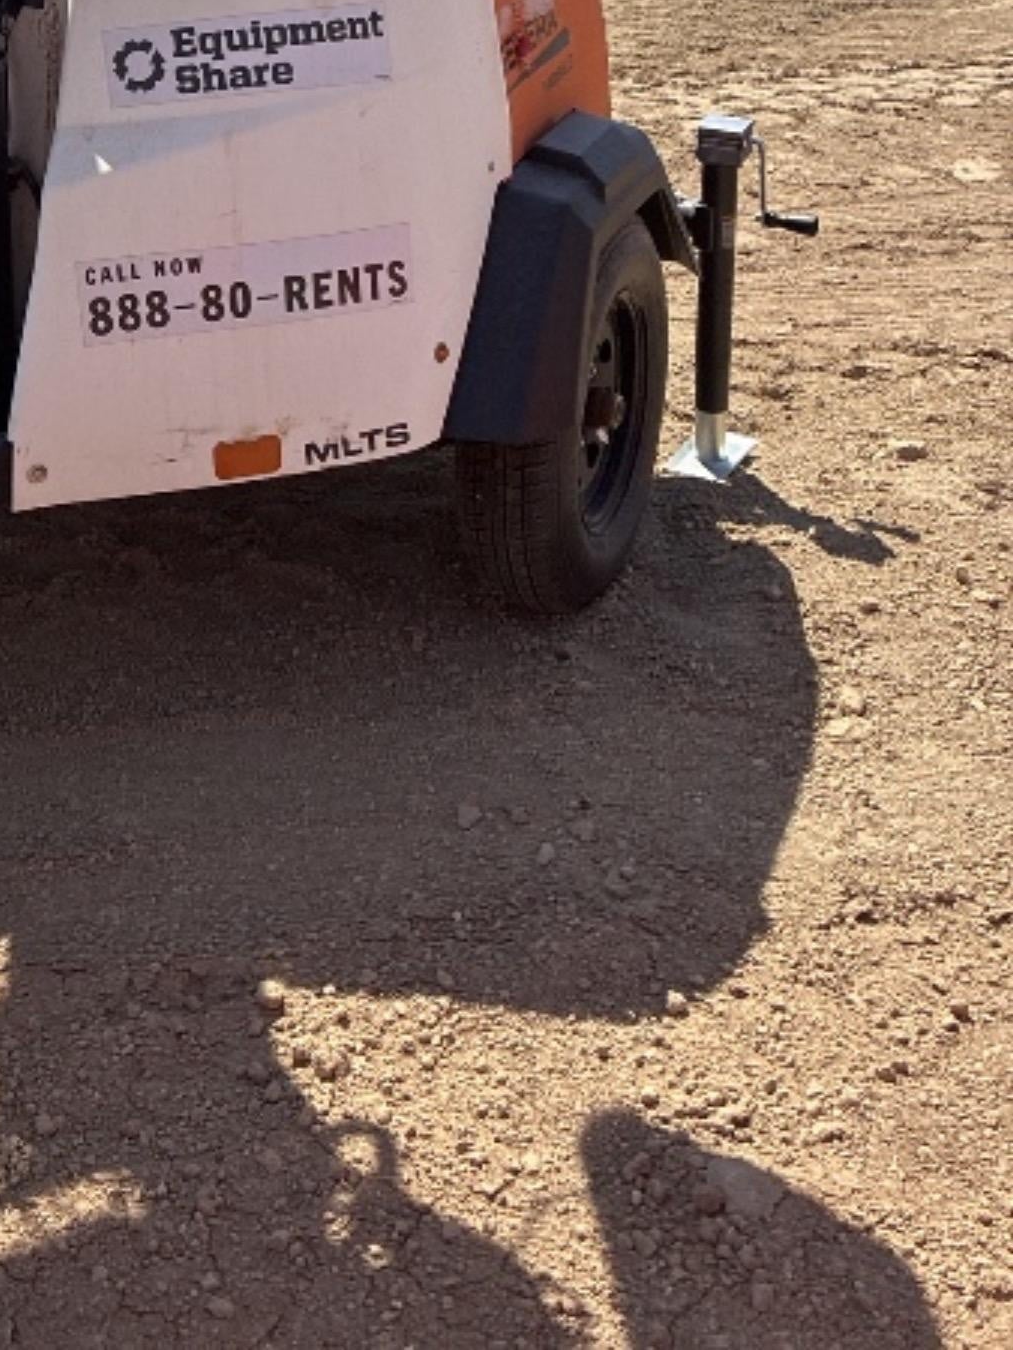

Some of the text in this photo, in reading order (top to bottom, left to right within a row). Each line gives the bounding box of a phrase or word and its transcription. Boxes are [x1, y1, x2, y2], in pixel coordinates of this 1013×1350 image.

[170, 11, 384, 60] Equipment
[175, 62, 294, 93] Share
[85, 257, 202, 286] CALL NOW
[89, 261, 408, 336] 888-80-RENTS
[304, 423, 410, 465] MLTS
